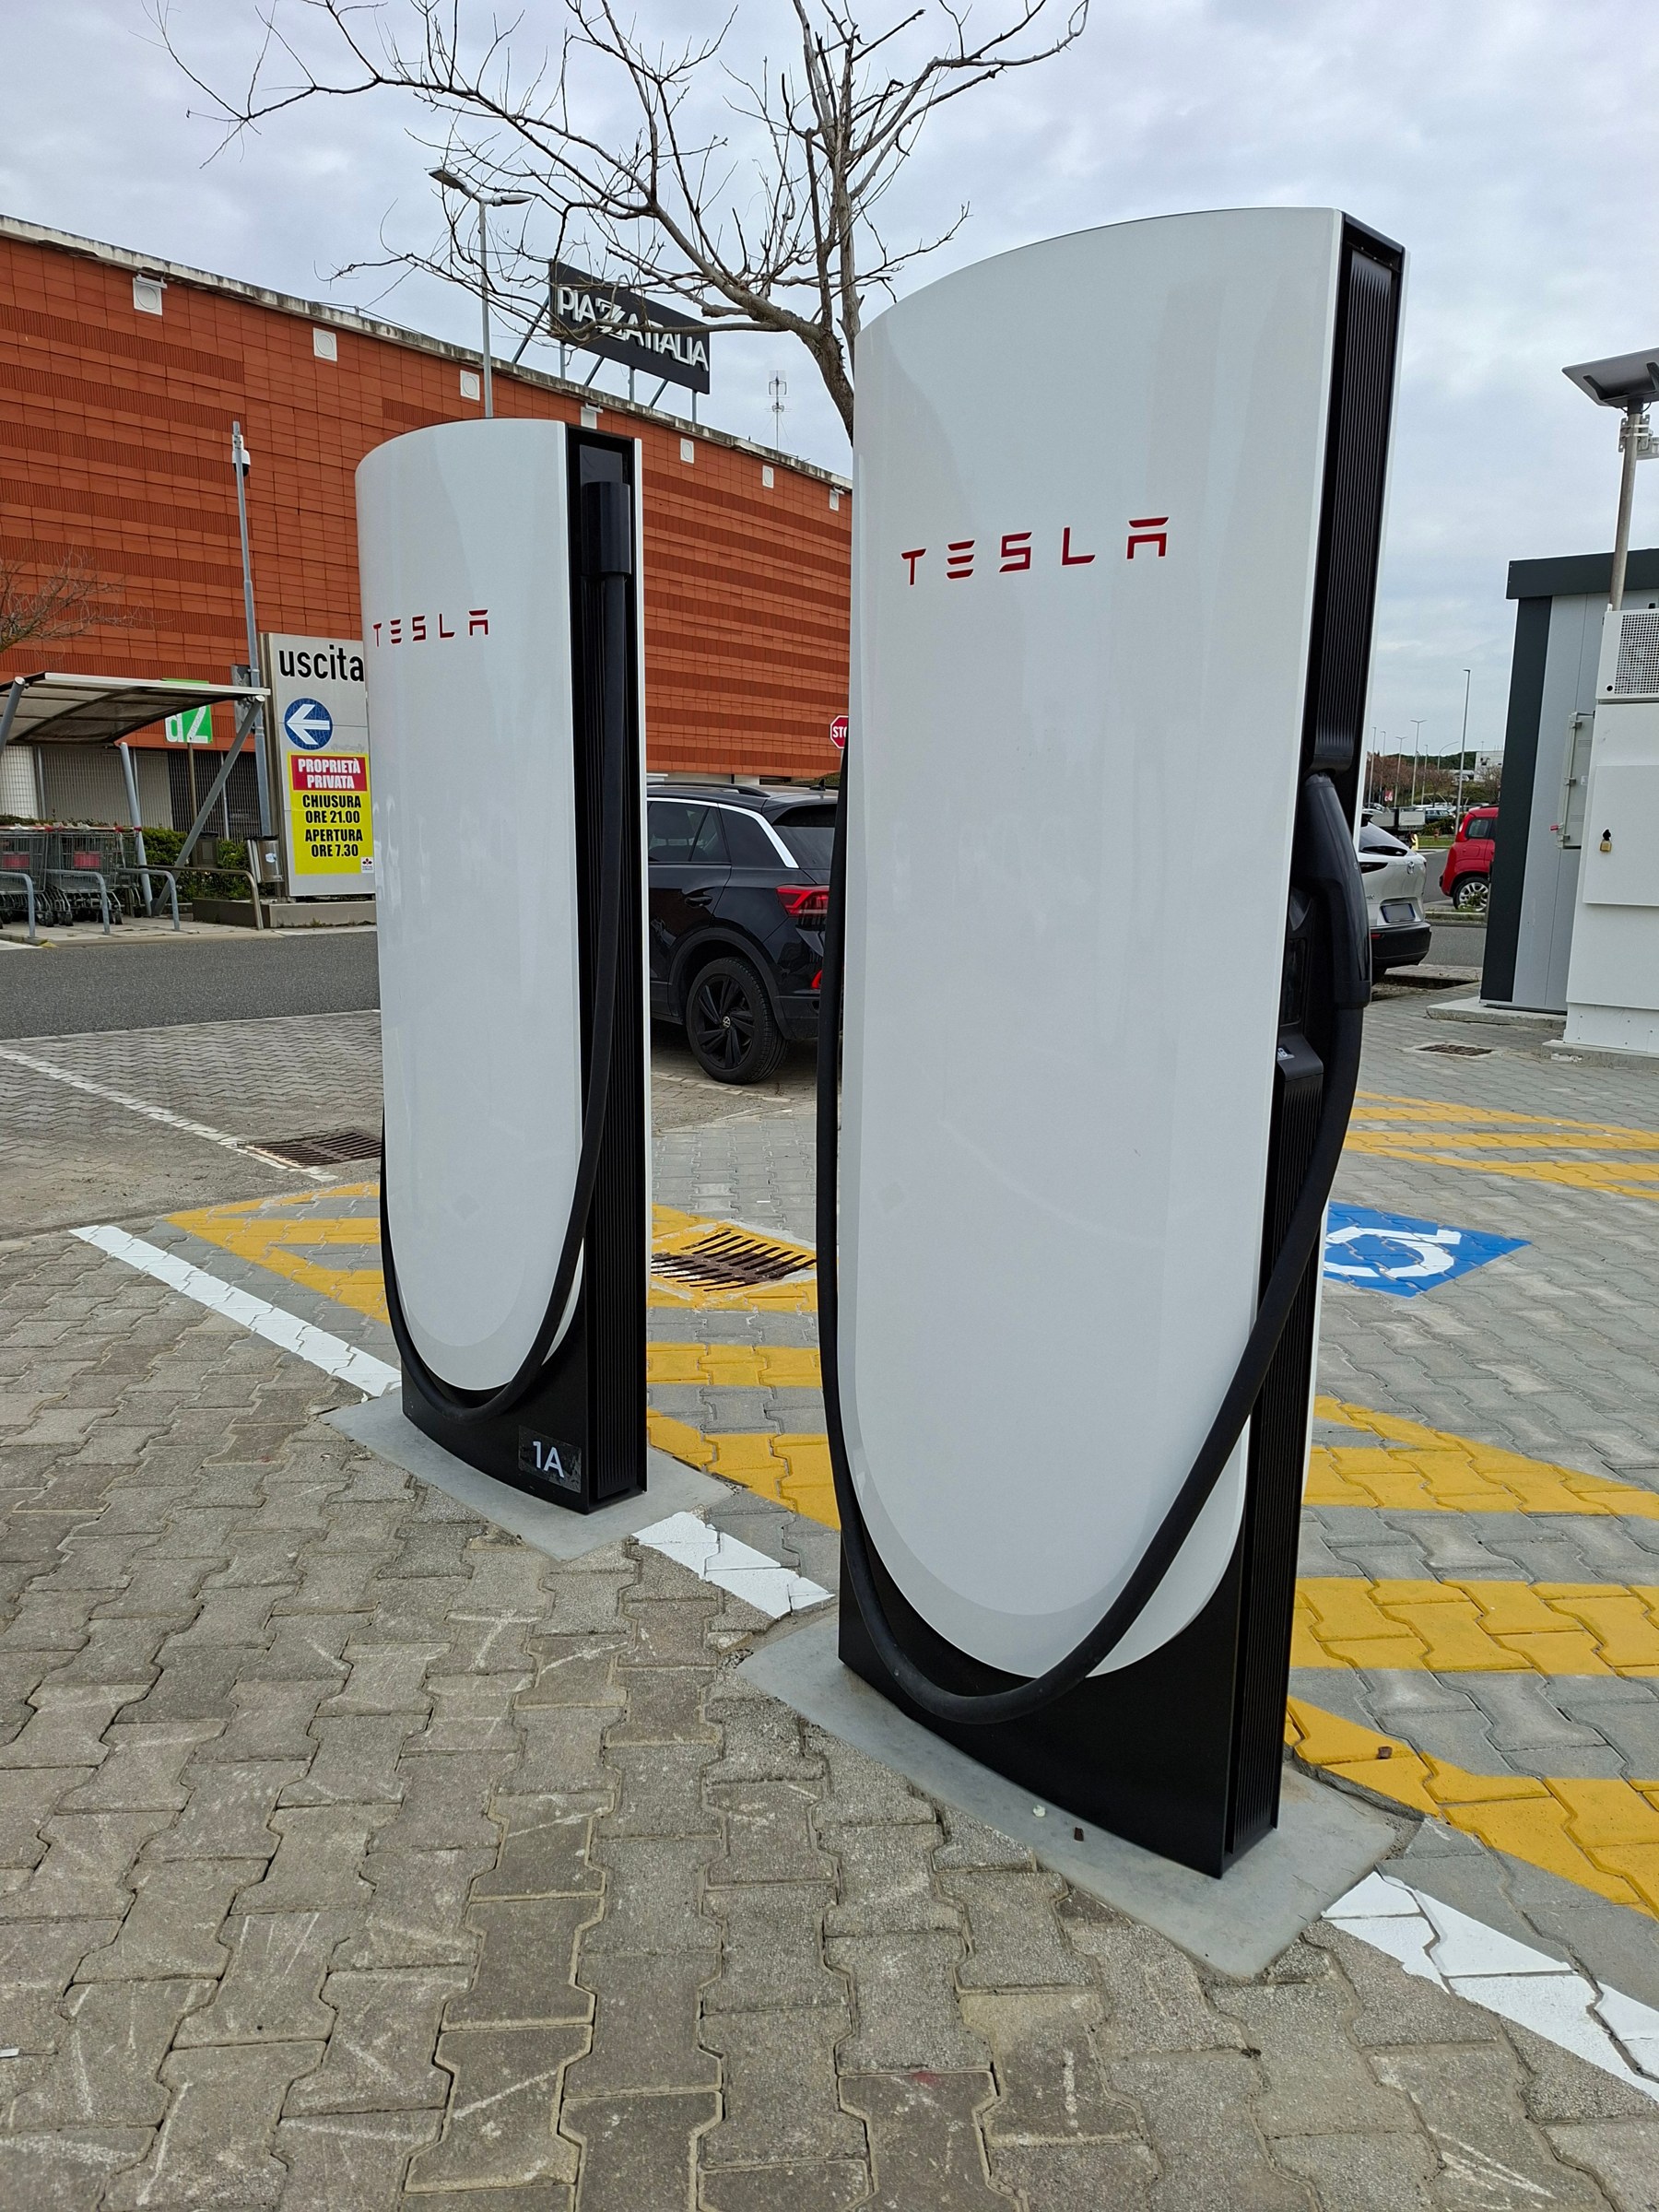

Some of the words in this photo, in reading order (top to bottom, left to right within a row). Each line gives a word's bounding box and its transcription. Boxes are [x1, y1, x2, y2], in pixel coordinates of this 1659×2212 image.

[900, 516, 1170, 586] TESLA
[372, 609, 489, 647] TESLA
[279, 644, 364, 682] uscita
[833, 726, 847, 738] ST
[298, 758, 361, 774] PROPRIETÀ
[306, 774, 355, 789] PRIVATA
[302, 794, 362, 808] CHIUSURA
[305, 810, 328, 824] ORE
[329, 810, 360, 824] 21.00
[304, 829, 363, 842] APERTURA
[311, 844, 334, 857] ORE
[335, 843, 359, 857] 7.30
[532, 1441, 565, 1478] 1A
